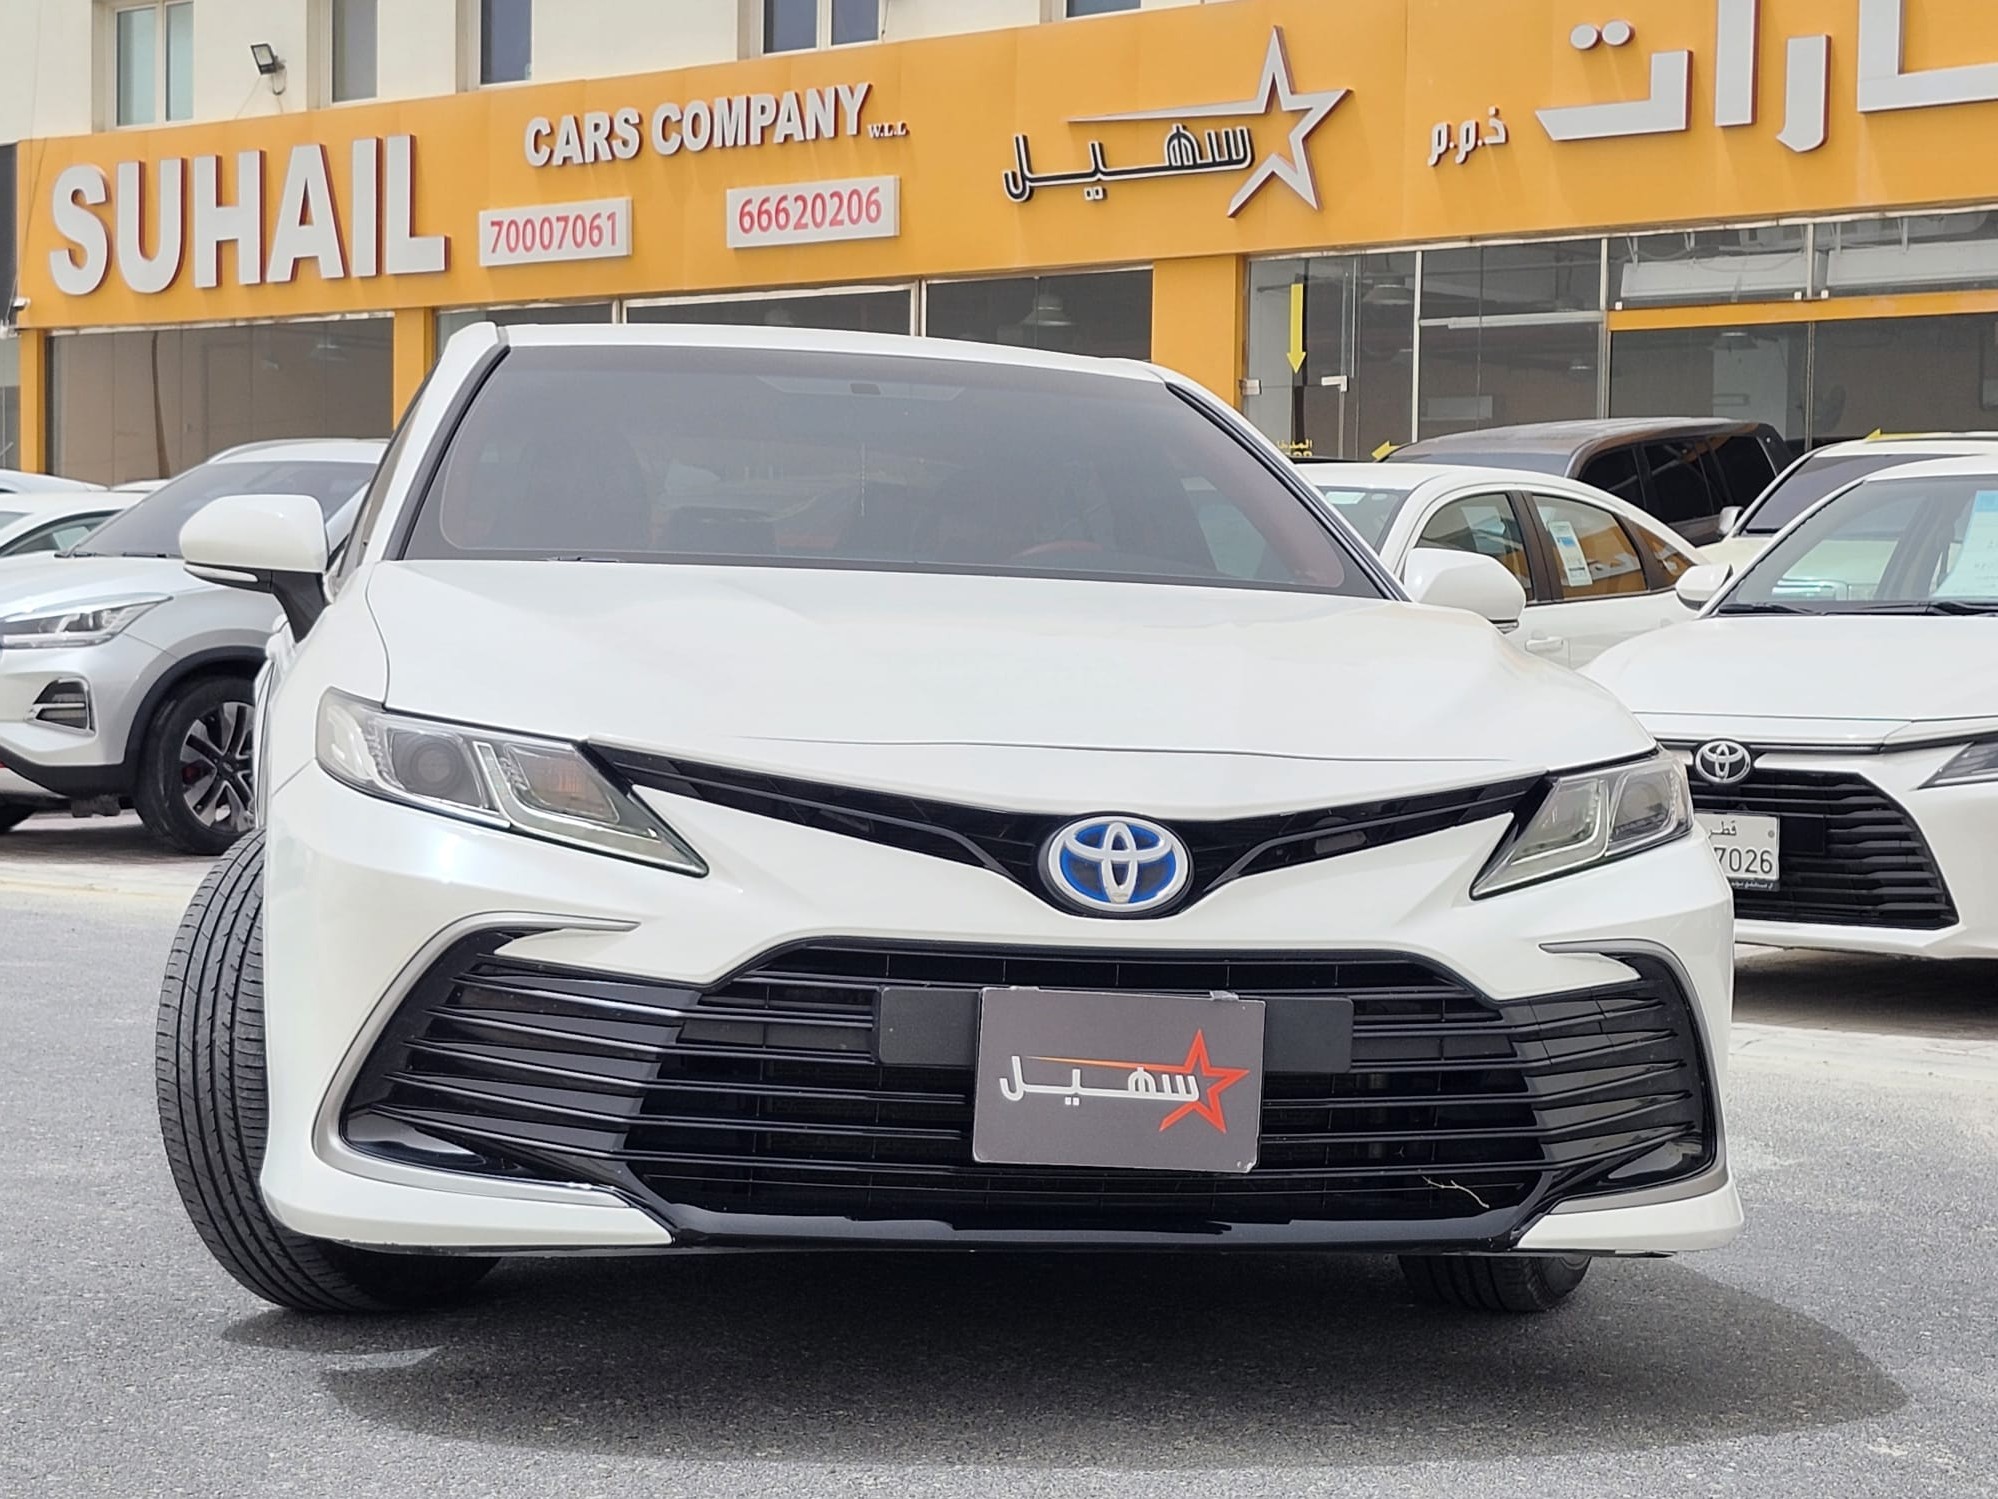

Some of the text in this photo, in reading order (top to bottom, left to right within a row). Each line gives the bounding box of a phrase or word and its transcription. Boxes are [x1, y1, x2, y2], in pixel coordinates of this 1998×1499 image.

[1534, 0, 1998, 152] ارات
[525, 108, 643, 168] CARS
[652, 82, 873, 156] COMPANY
[1002, 124, 1254, 202] سهيل
[49, 134, 451, 296] SUHAIL
[490, 211, 618, 254] 70007061
[738, 185, 882, 234] 66620206
[1707, 820, 1737, 840] قطر
[1713, 846, 1773, 875] 7026
[999, 1054, 1199, 1106] سهيل
